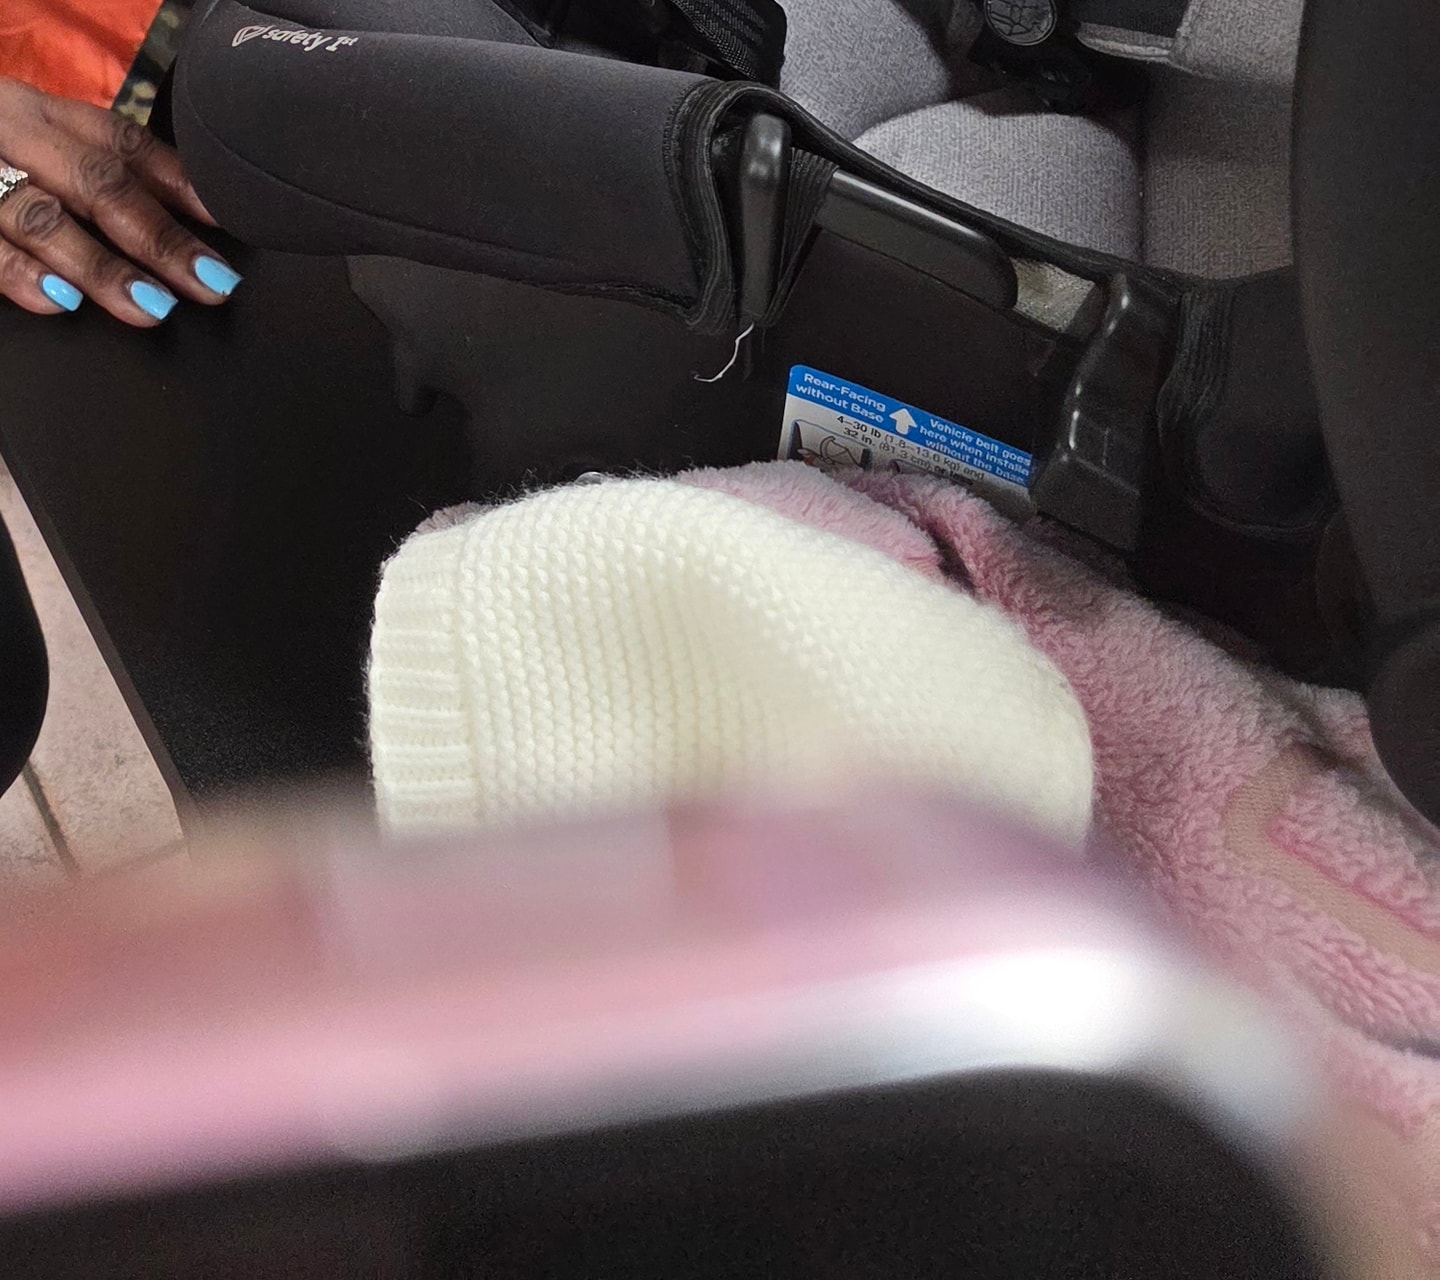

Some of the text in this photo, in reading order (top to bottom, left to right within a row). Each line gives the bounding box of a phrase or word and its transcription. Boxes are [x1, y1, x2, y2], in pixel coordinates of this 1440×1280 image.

[262, 29, 332, 51] safety
[796, 383, 884, 424] without Base
[804, 372, 886, 413] Rear-Facing
[843, 427, 859, 439] 32
[861, 433, 876, 447] in.
[870, 427, 881, 439] lb
[930, 418, 973, 443] Vehicle
[975, 436, 999, 454] belt
[920, 425, 1030, 476] here when installe
[926, 439, 970, 464] without
[973, 459, 993, 472] the
